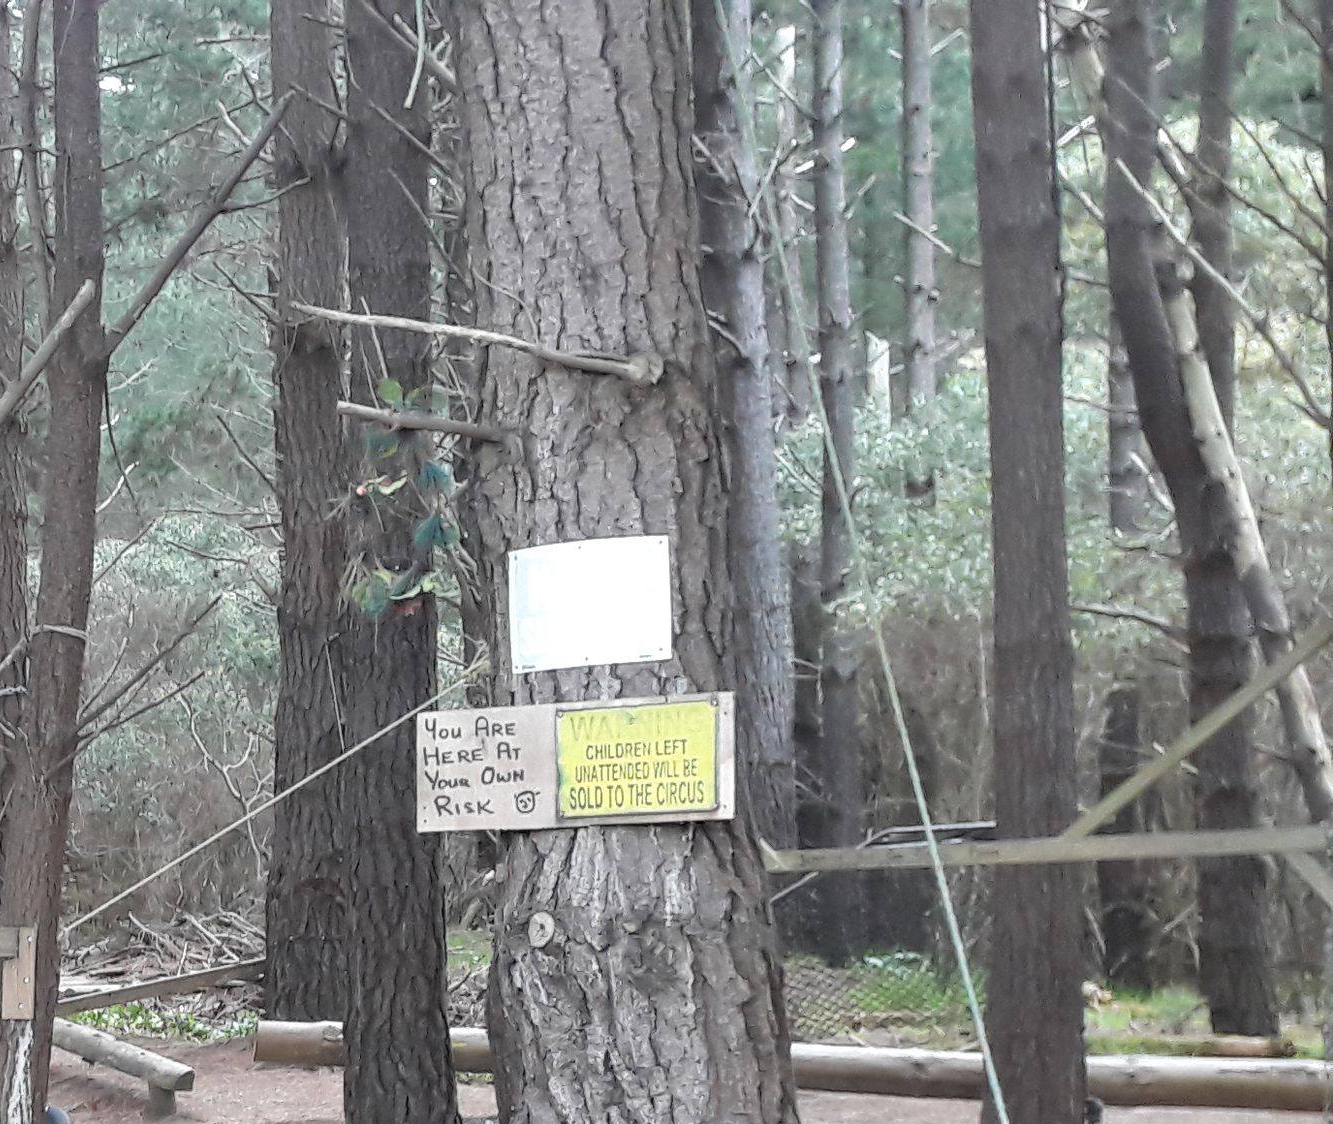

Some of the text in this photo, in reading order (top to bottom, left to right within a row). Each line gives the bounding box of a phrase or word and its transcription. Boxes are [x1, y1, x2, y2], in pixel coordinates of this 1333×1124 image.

[422, 746, 485, 767] HERE
[586, 739, 687, 761] CHILDREN LEFT
[575, 758, 698, 784] UNATTENDED WILL BE
[569, 780, 705, 810] SOLD TO THE CIRCUS
